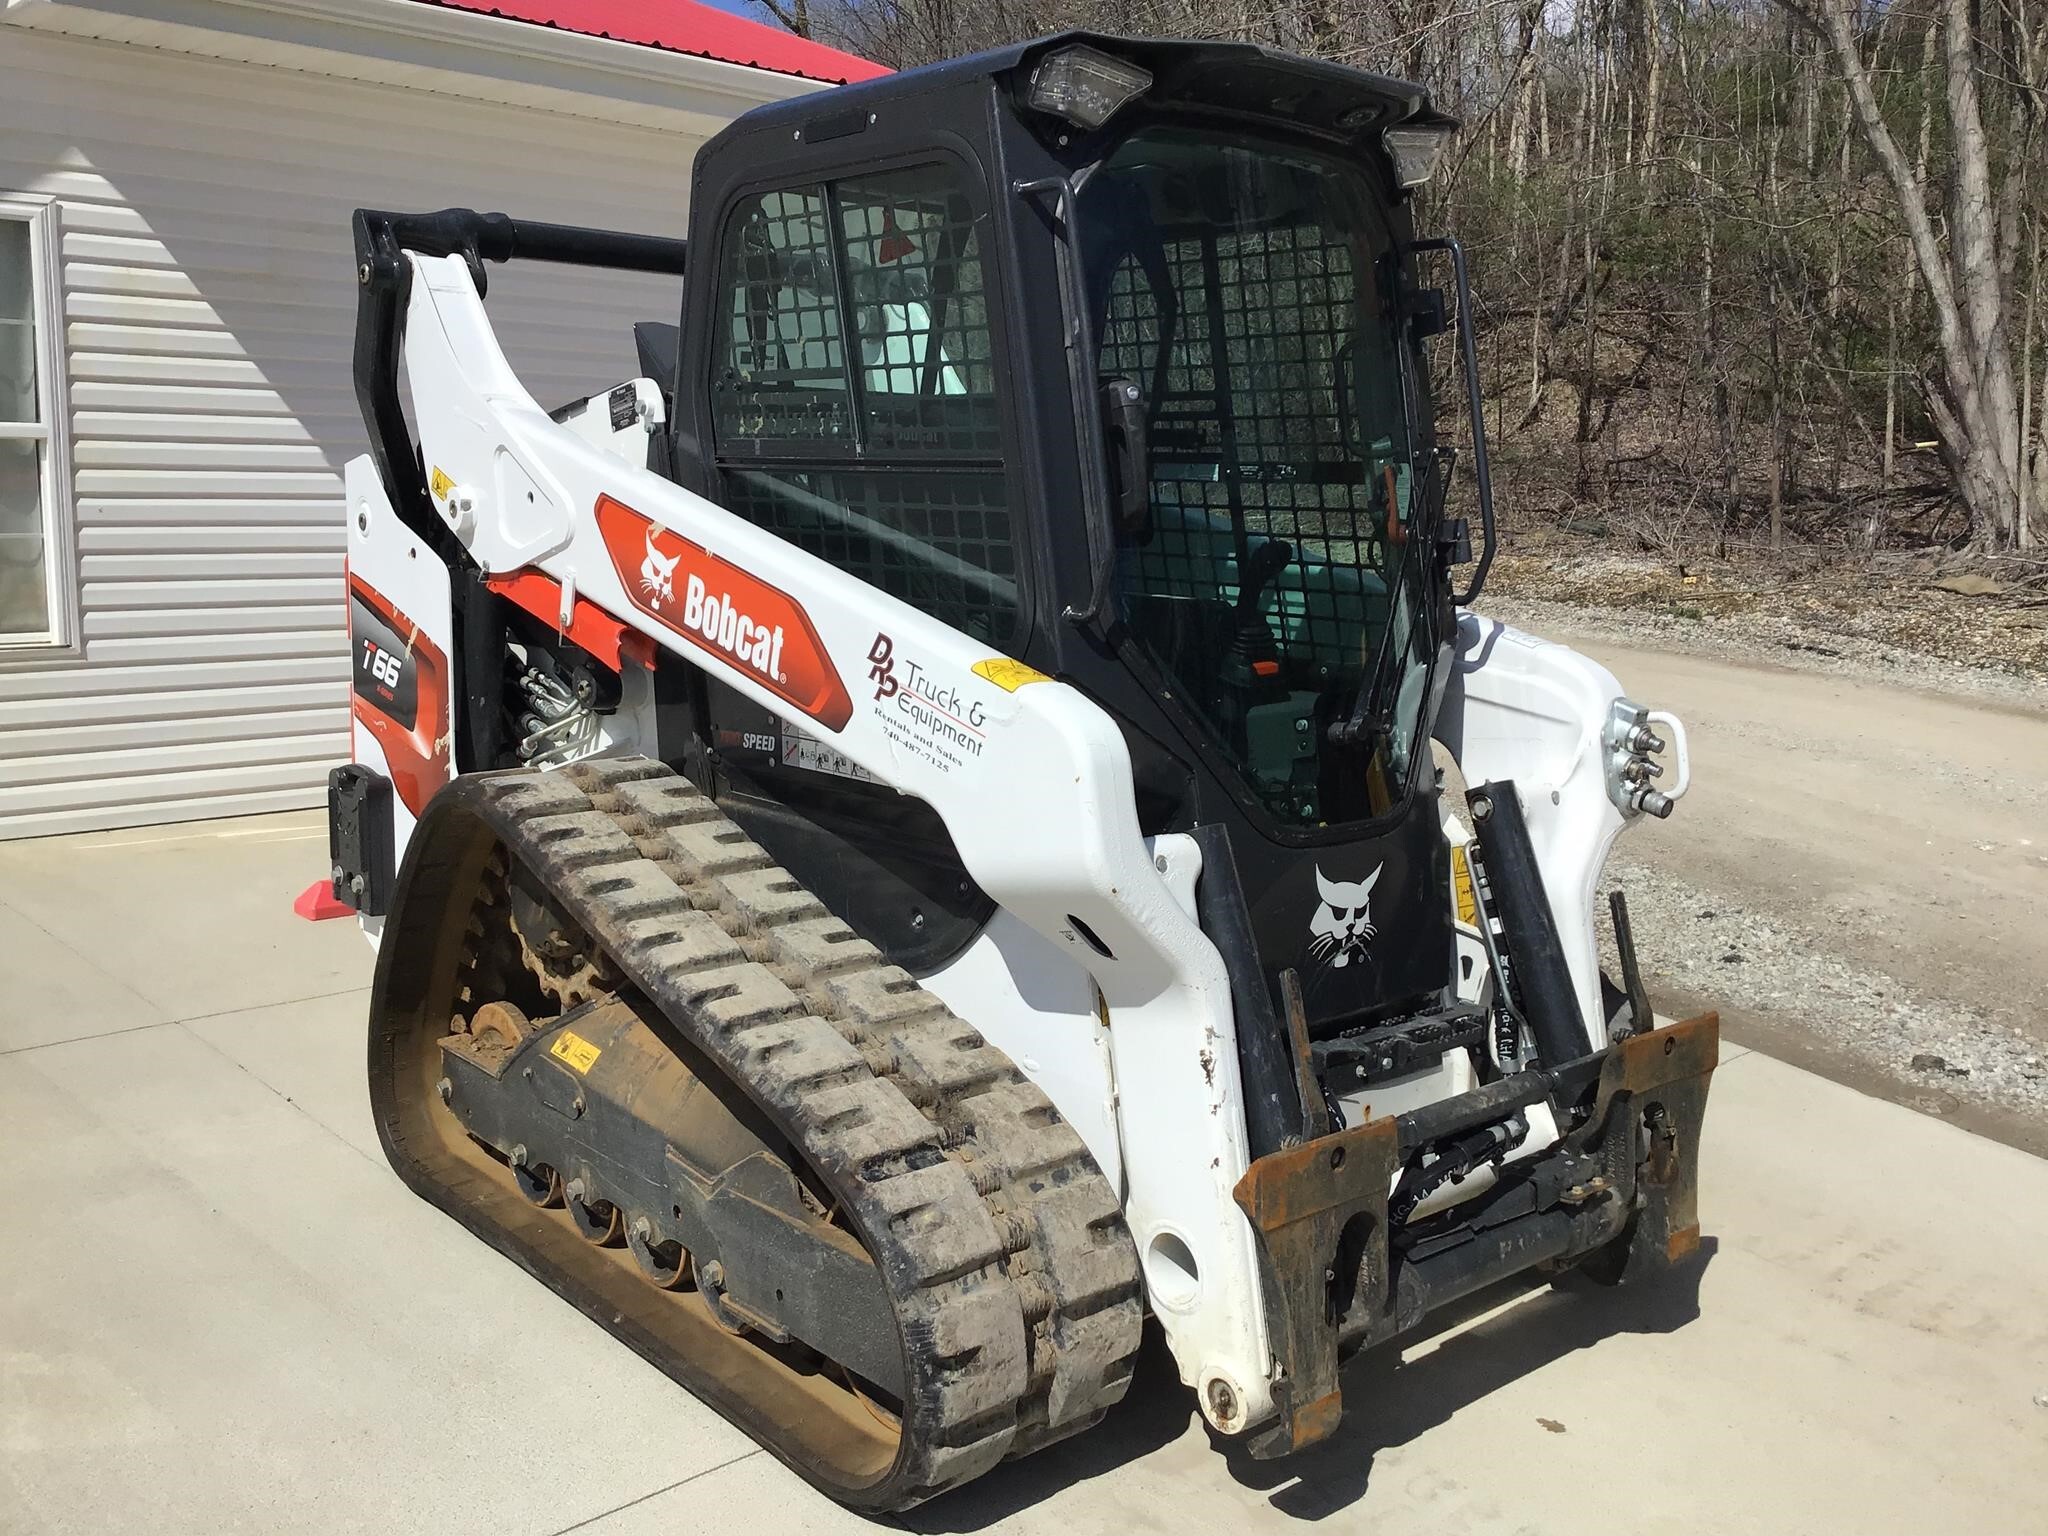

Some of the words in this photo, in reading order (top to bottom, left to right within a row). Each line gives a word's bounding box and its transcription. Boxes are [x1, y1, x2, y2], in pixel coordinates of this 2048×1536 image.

[683, 573, 784, 681] Bobcat
[363, 639, 402, 689] T66
[906, 660, 961, 717] Truck
[969, 701, 987, 728] &
[742, 732, 776, 752] SPEED
[874, 707, 912, 735] Rentals
[913, 733, 933, 749] and
[936, 745, 963, 767] Sales
[882, 726, 950, 773] 740-487-7125
[898, 692, 984, 757] Equipment
